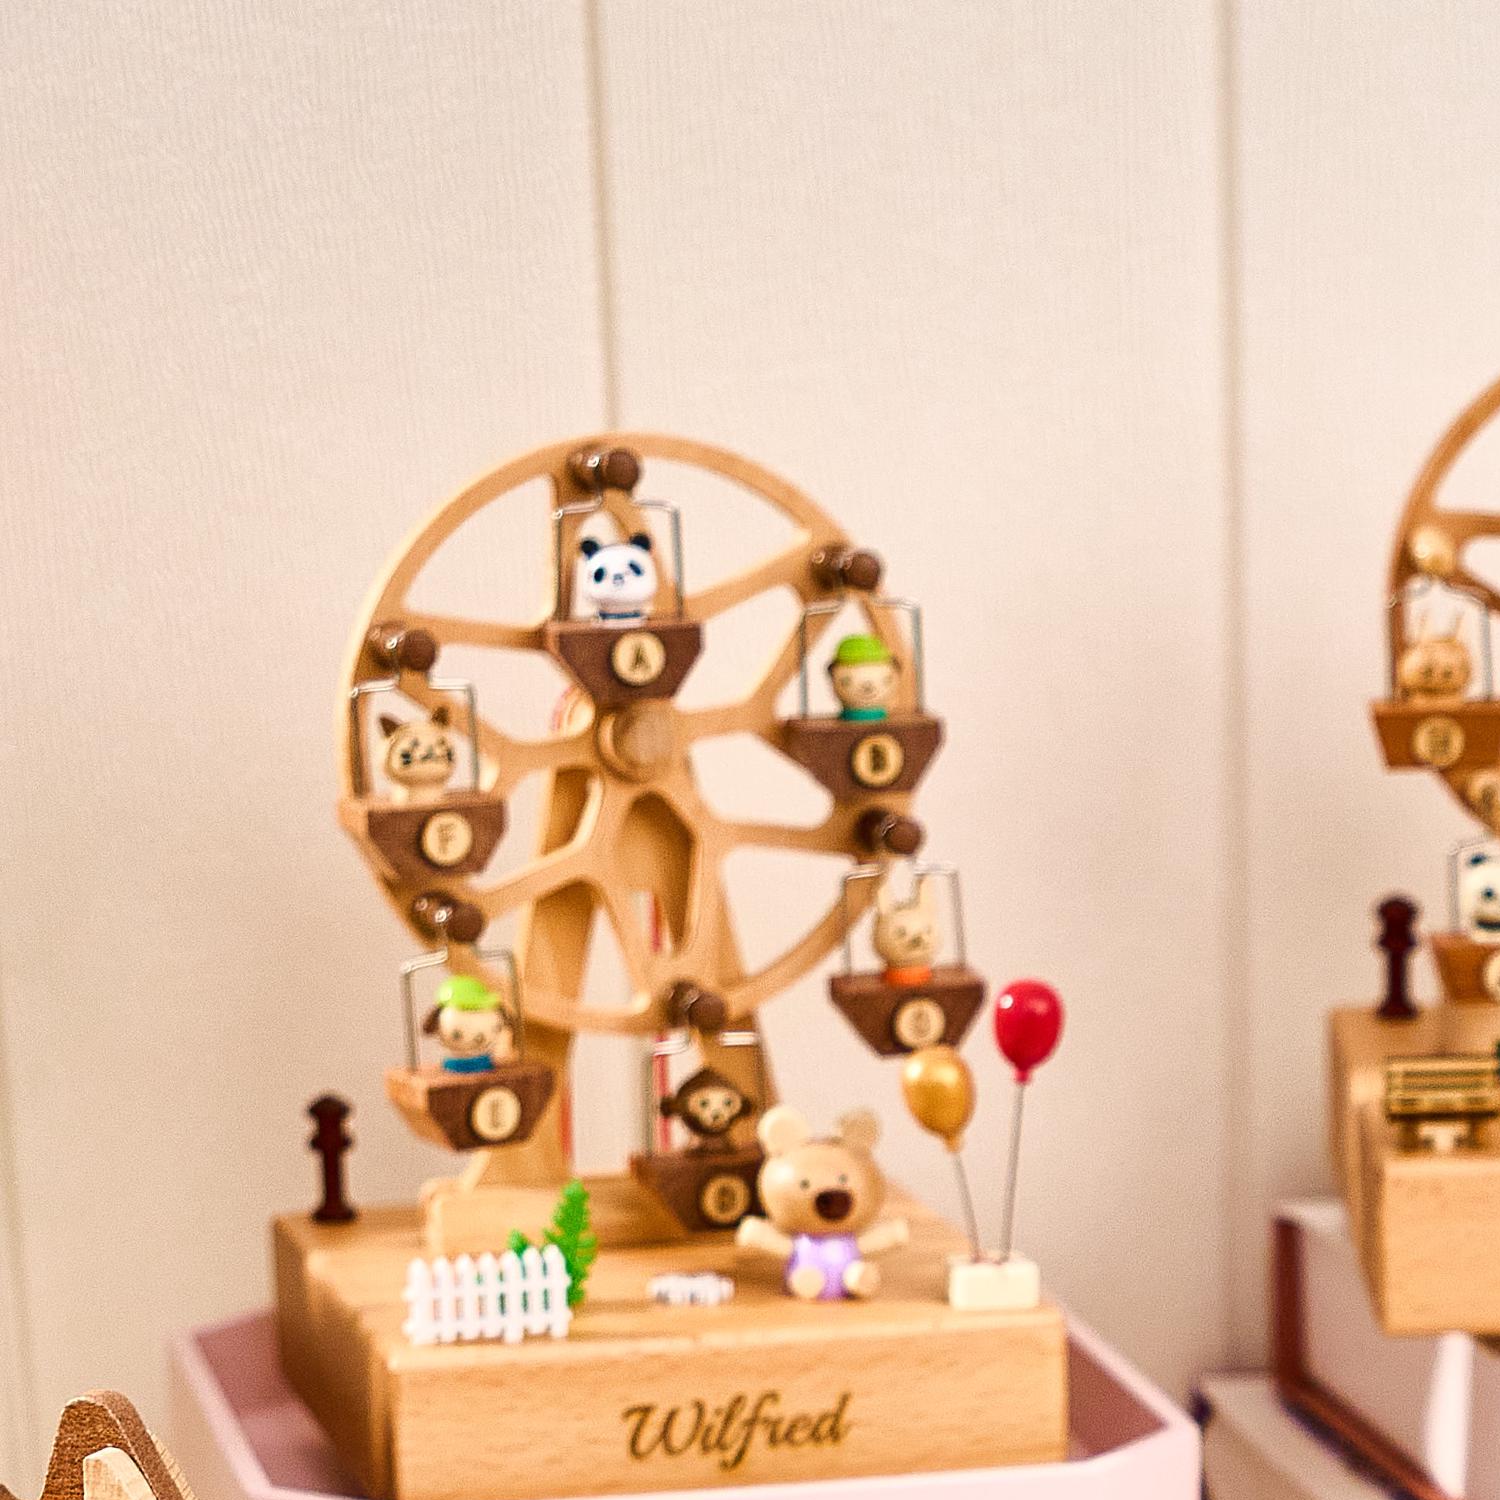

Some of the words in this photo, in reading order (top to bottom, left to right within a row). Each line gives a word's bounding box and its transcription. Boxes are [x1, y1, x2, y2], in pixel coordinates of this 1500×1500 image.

[628, 642, 652, 671] A
[437, 823, 458, 854] F
[621, 1389, 853, 1473] Wilfred
